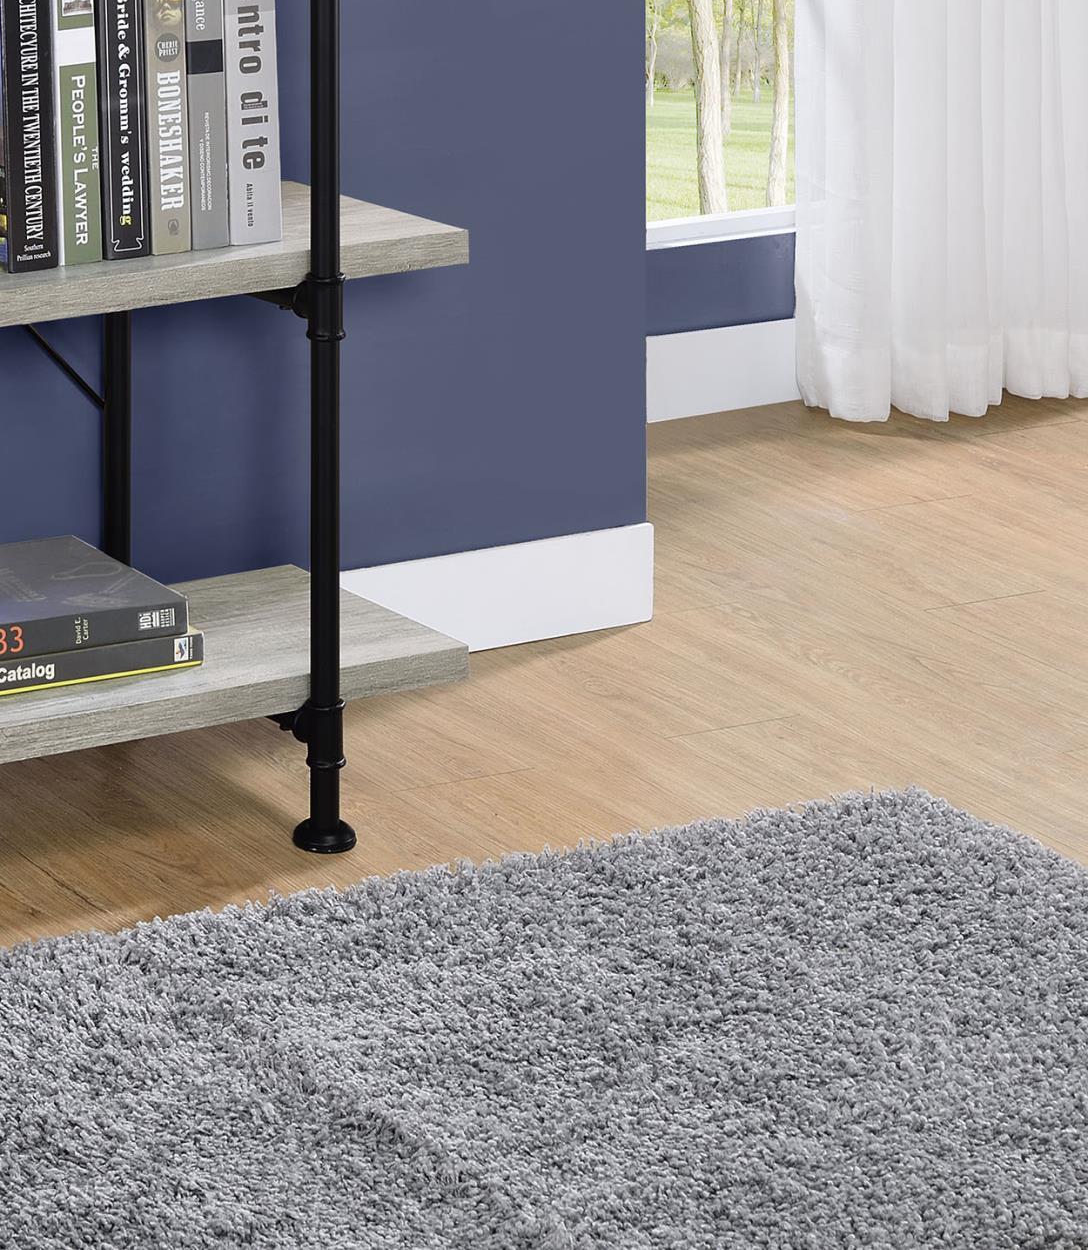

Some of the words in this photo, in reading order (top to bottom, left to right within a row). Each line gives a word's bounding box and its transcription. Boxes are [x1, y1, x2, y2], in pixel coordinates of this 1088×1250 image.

[21, 72, 39, 87] IN
[118, 43, 131, 61] &
[22, 87, 40, 113] THE
[71, 75, 88, 164] PEOPLE'S
[118, 63, 132, 145] Gromm's
[240, 91, 268, 126] di
[23, 113, 42, 184] TWENTIETH
[157, 70, 184, 212] BONESHAKER
[242, 136, 268, 170] te
[25, 185, 44, 240] CENTURY
[74, 168, 89, 246] LAWYER
[120, 151, 134, 226] wedding
[74, 624, 82, 644] David
